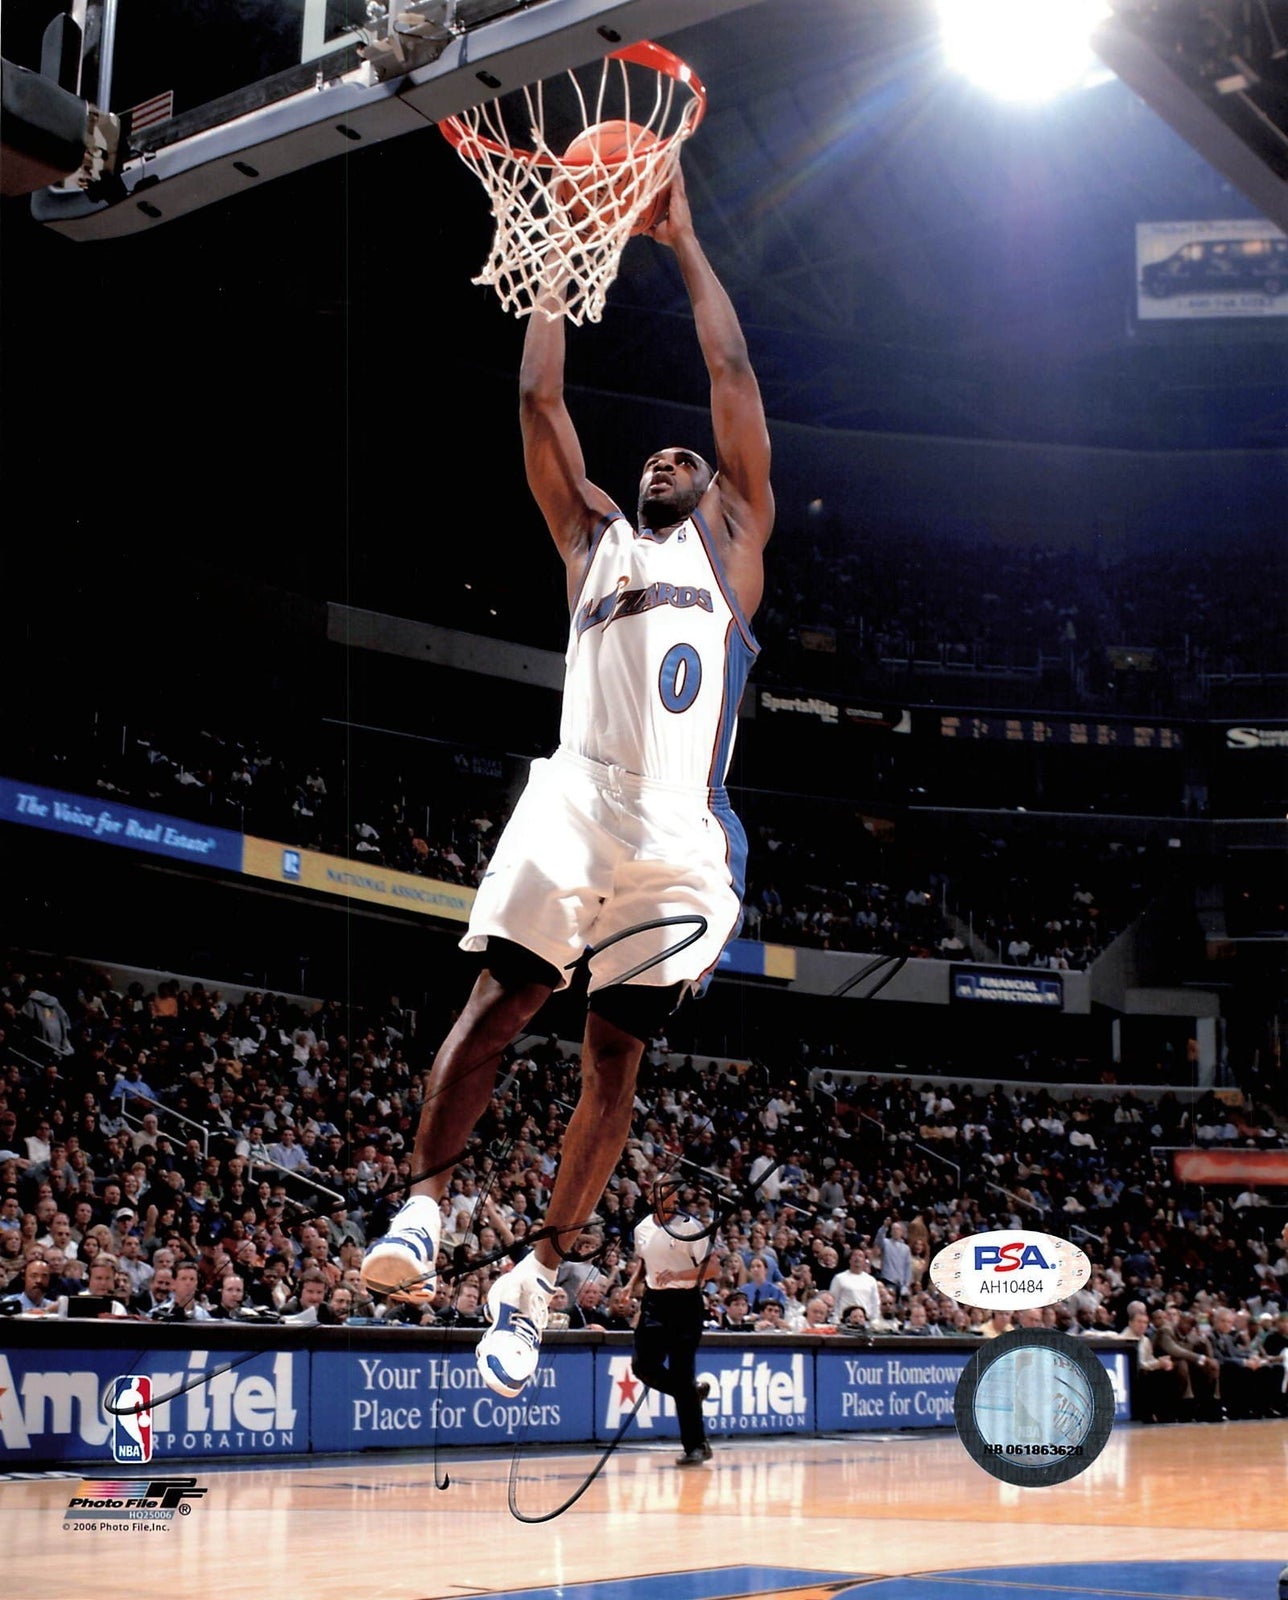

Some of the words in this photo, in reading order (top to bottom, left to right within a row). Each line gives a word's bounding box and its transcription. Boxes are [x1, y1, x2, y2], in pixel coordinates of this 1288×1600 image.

[658, 643, 702, 714] 0
[16, 792, 49, 817] The
[53, 801, 95, 827] Voice
[93, 811, 123, 836] for
[125, 819, 162, 843] Real
[358, 1359, 421, 1390] Your
[844, 1361, 883, 1385] Your
[0, 1350, 297, 1449] mritel
[841, 1392, 883, 1417] Place
[889, 1391, 911, 1416] for
[353, 1400, 421, 1430] Place
[430, 1398, 466, 1428] for
[473, 1397, 561, 1435] Copiers
[708, 1415, 806, 1430] ORPORATION
[110, 1431, 294, 1450] RPORATION
